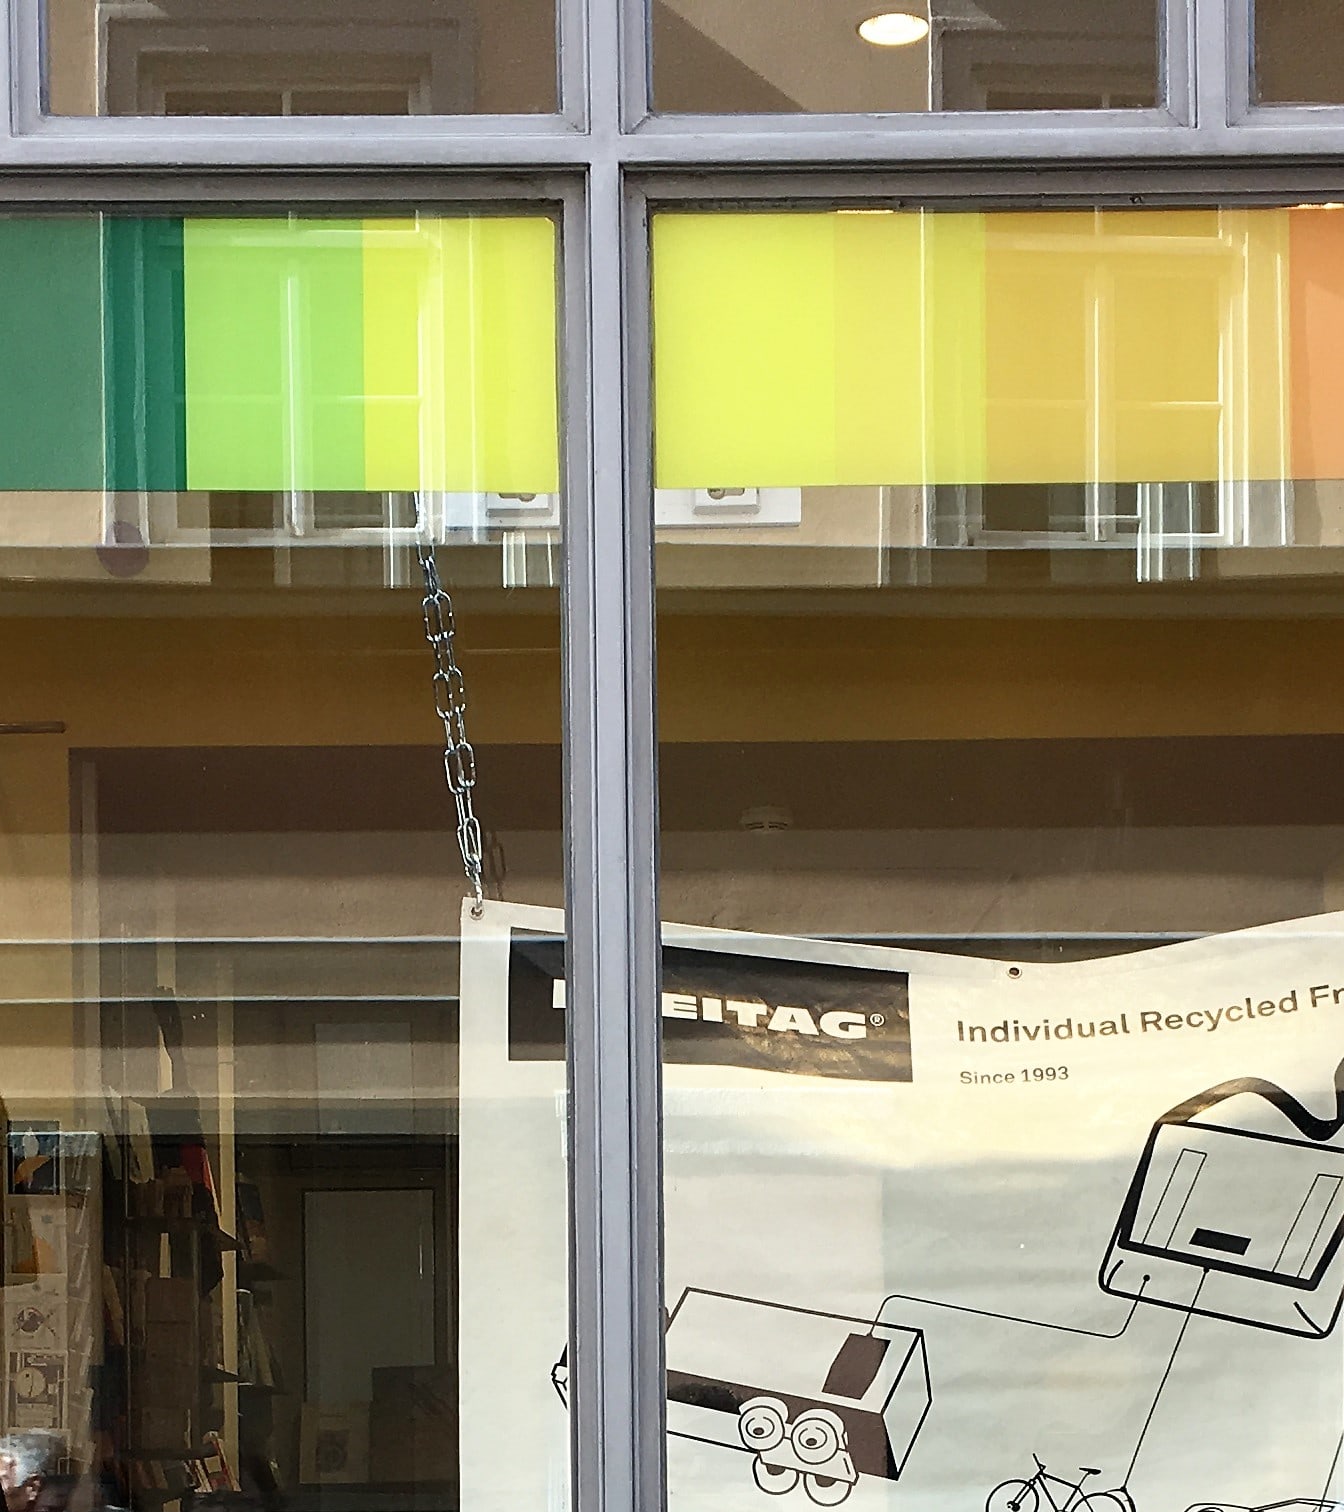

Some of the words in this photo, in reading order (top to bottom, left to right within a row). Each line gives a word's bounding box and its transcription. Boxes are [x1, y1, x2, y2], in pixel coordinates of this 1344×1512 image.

[957, 1013, 1130, 1043] Individual
[1140, 990, 1298, 1032] Recycled
[959, 1070, 1015, 1085] Since
[1021, 1066, 1069, 1083] 1993
